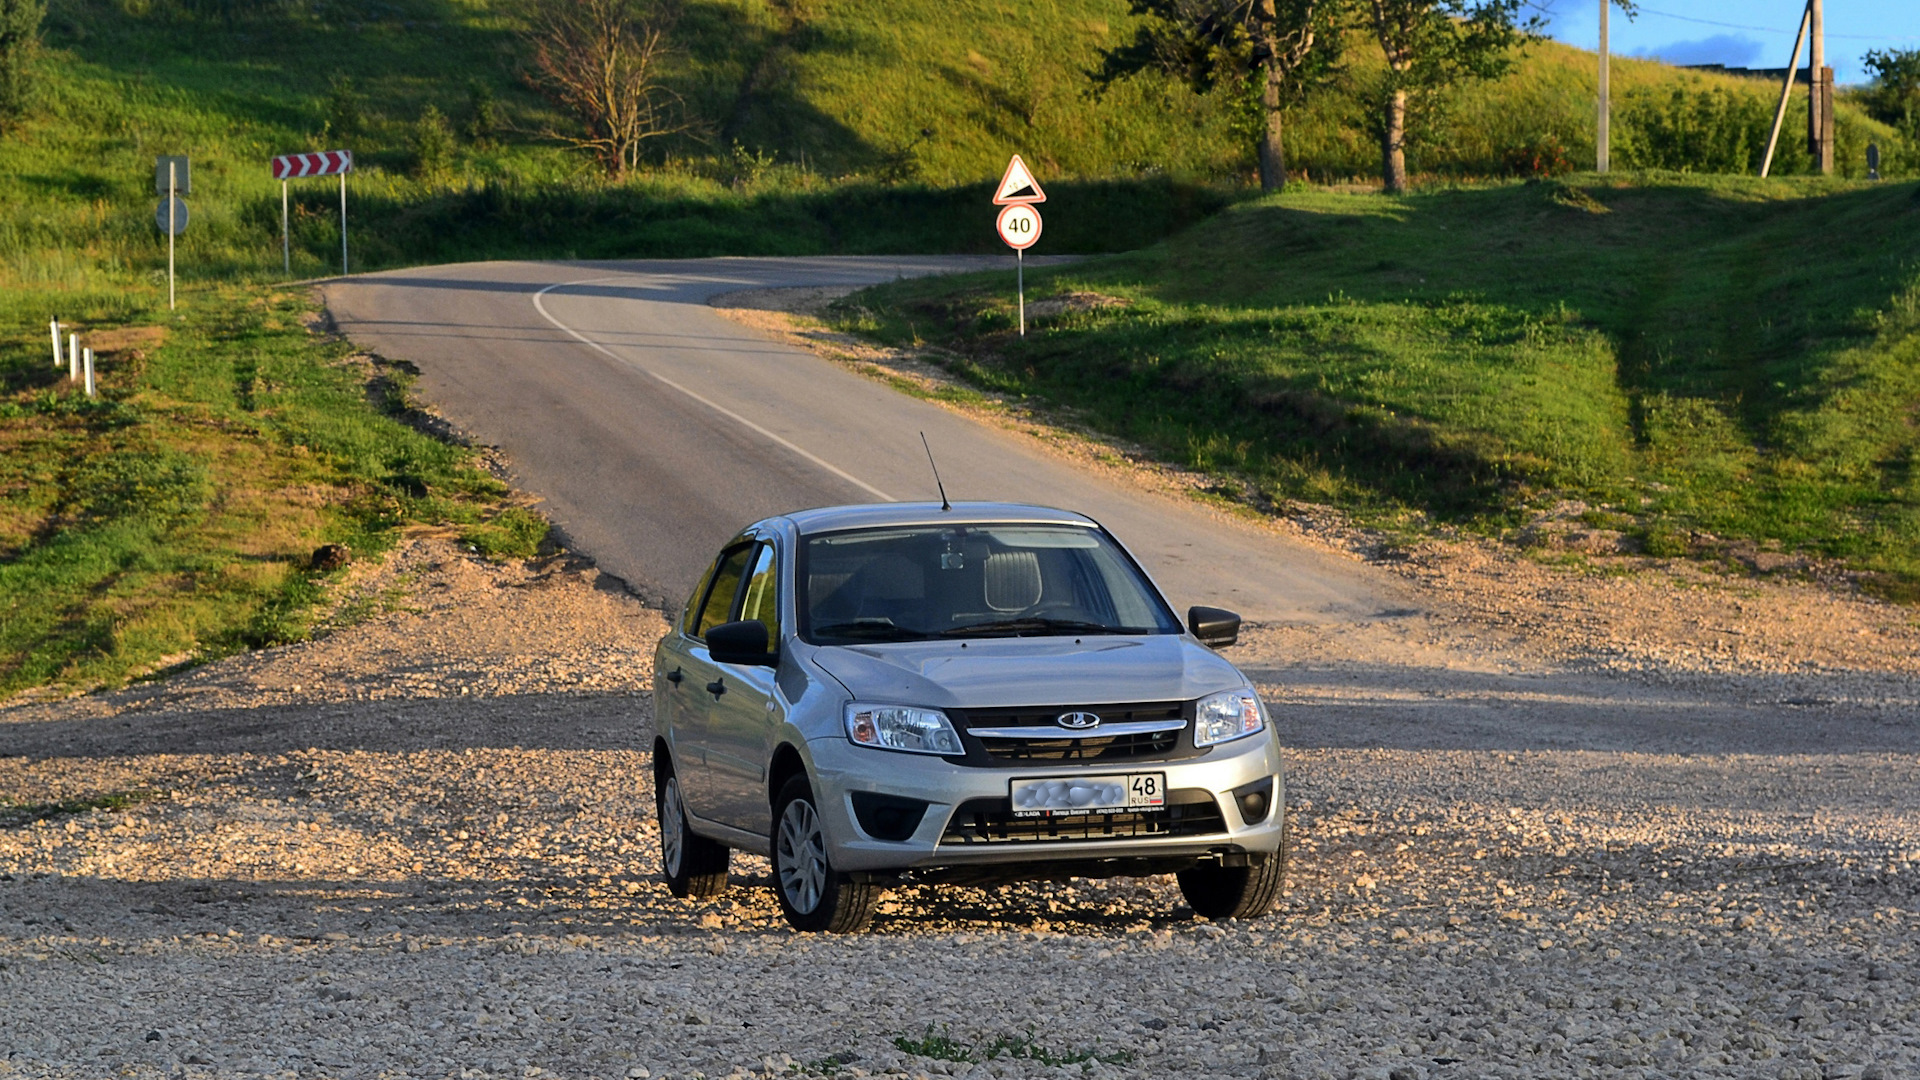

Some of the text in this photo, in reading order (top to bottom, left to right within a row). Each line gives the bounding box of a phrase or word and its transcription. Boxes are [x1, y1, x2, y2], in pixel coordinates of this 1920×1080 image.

[1008, 217, 1031, 234] 40
[1132, 777, 1156, 796] 48
[1131, 796, 1150, 804] RUS
